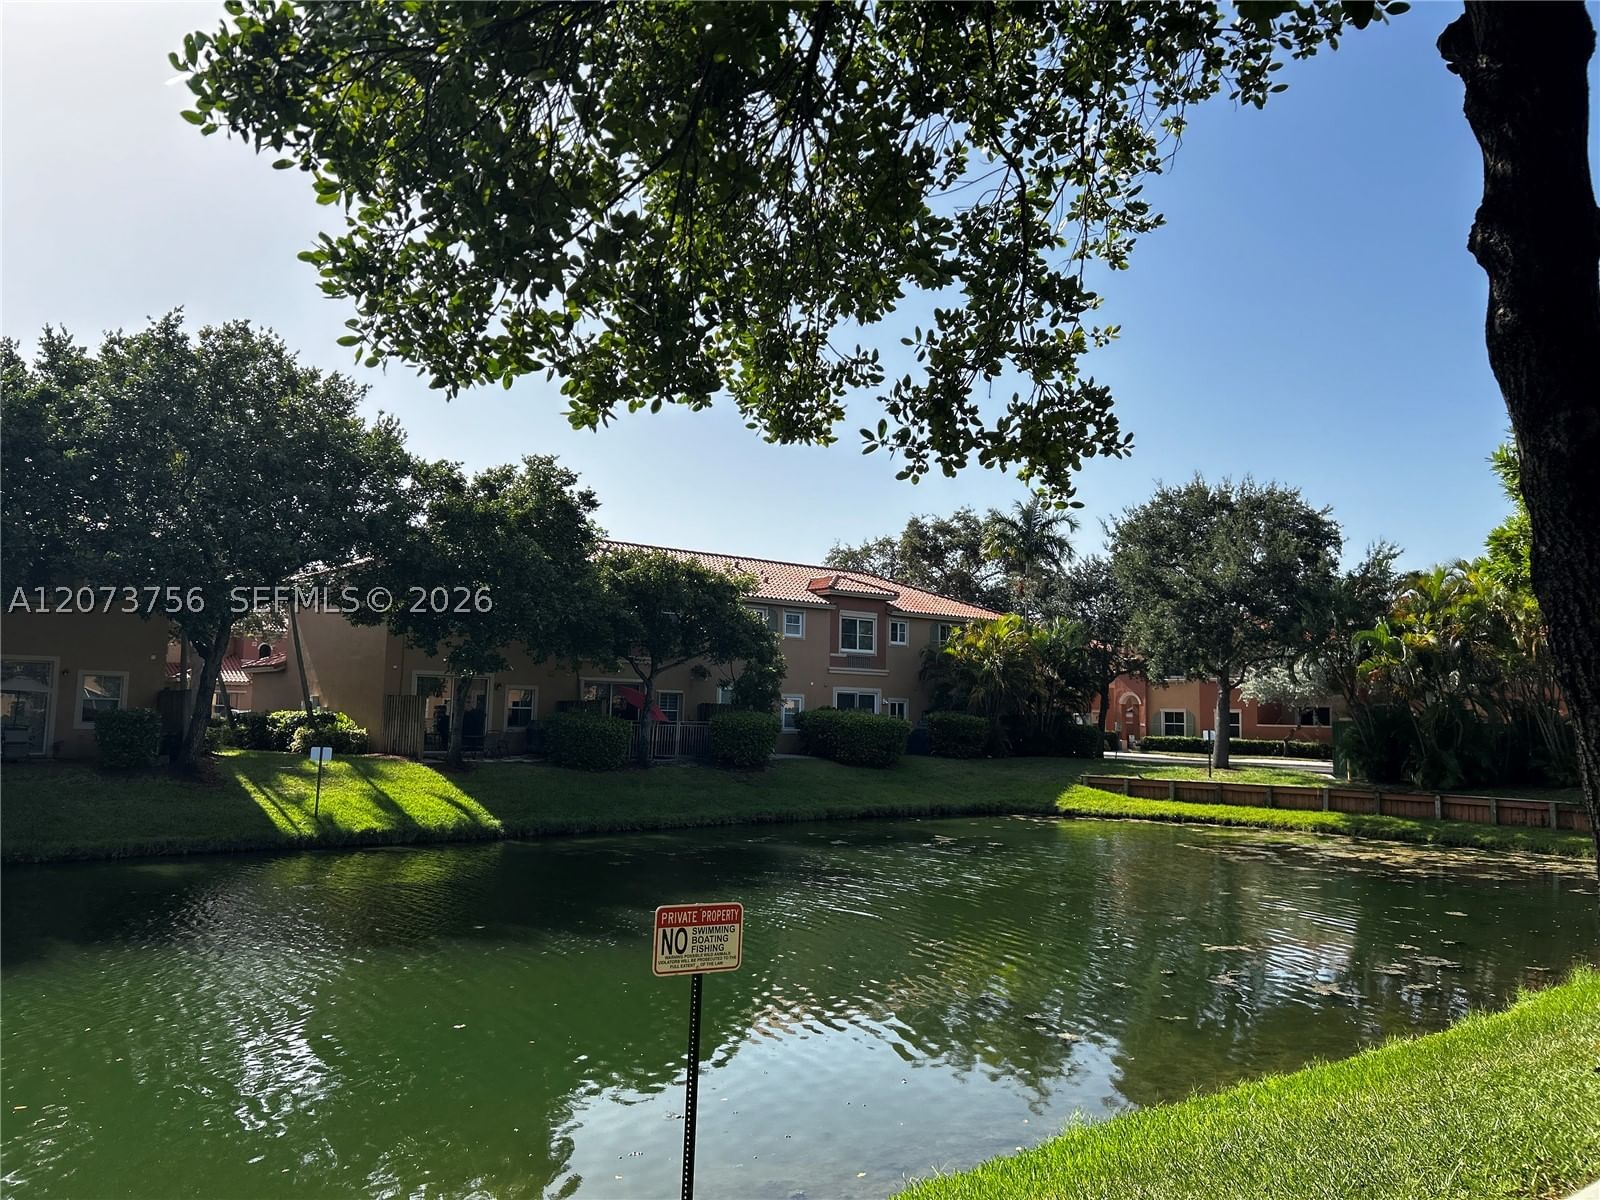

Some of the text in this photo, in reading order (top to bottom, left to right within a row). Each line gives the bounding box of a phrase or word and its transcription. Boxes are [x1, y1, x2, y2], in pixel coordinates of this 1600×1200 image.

[662, 910, 739, 925] PRIVATE PROPERTY
[693, 926, 736, 935] SWIMMING
[662, 928, 688, 956] NO
[692, 935, 729, 944] BOATING
[692, 944, 725, 953] FISHING
